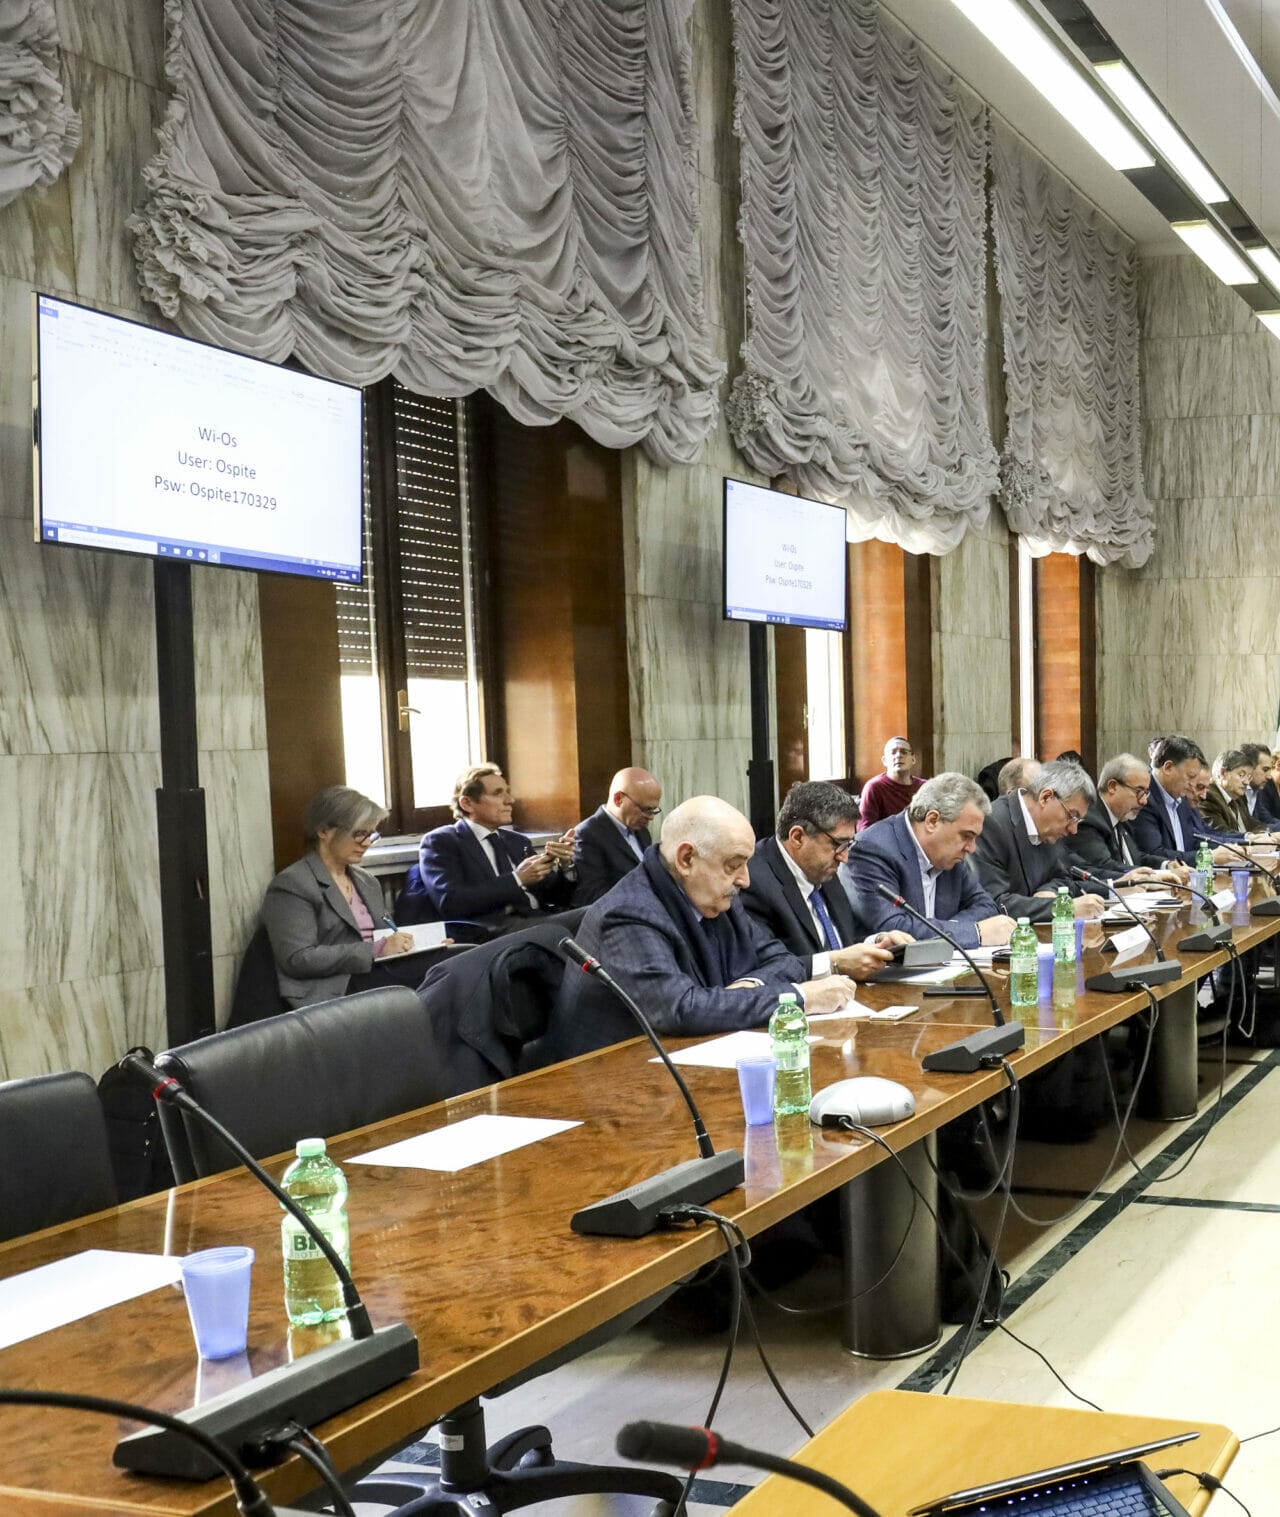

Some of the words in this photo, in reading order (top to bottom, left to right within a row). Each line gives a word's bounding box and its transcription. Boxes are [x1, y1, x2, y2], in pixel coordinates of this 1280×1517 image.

[198, 426, 238, 448] Wi-Os
[178, 450, 212, 471] User:
[216, 459, 257, 480] Ospite
[154, 475, 186, 494] Psw:
[190, 482, 277, 511] Ospite170329
